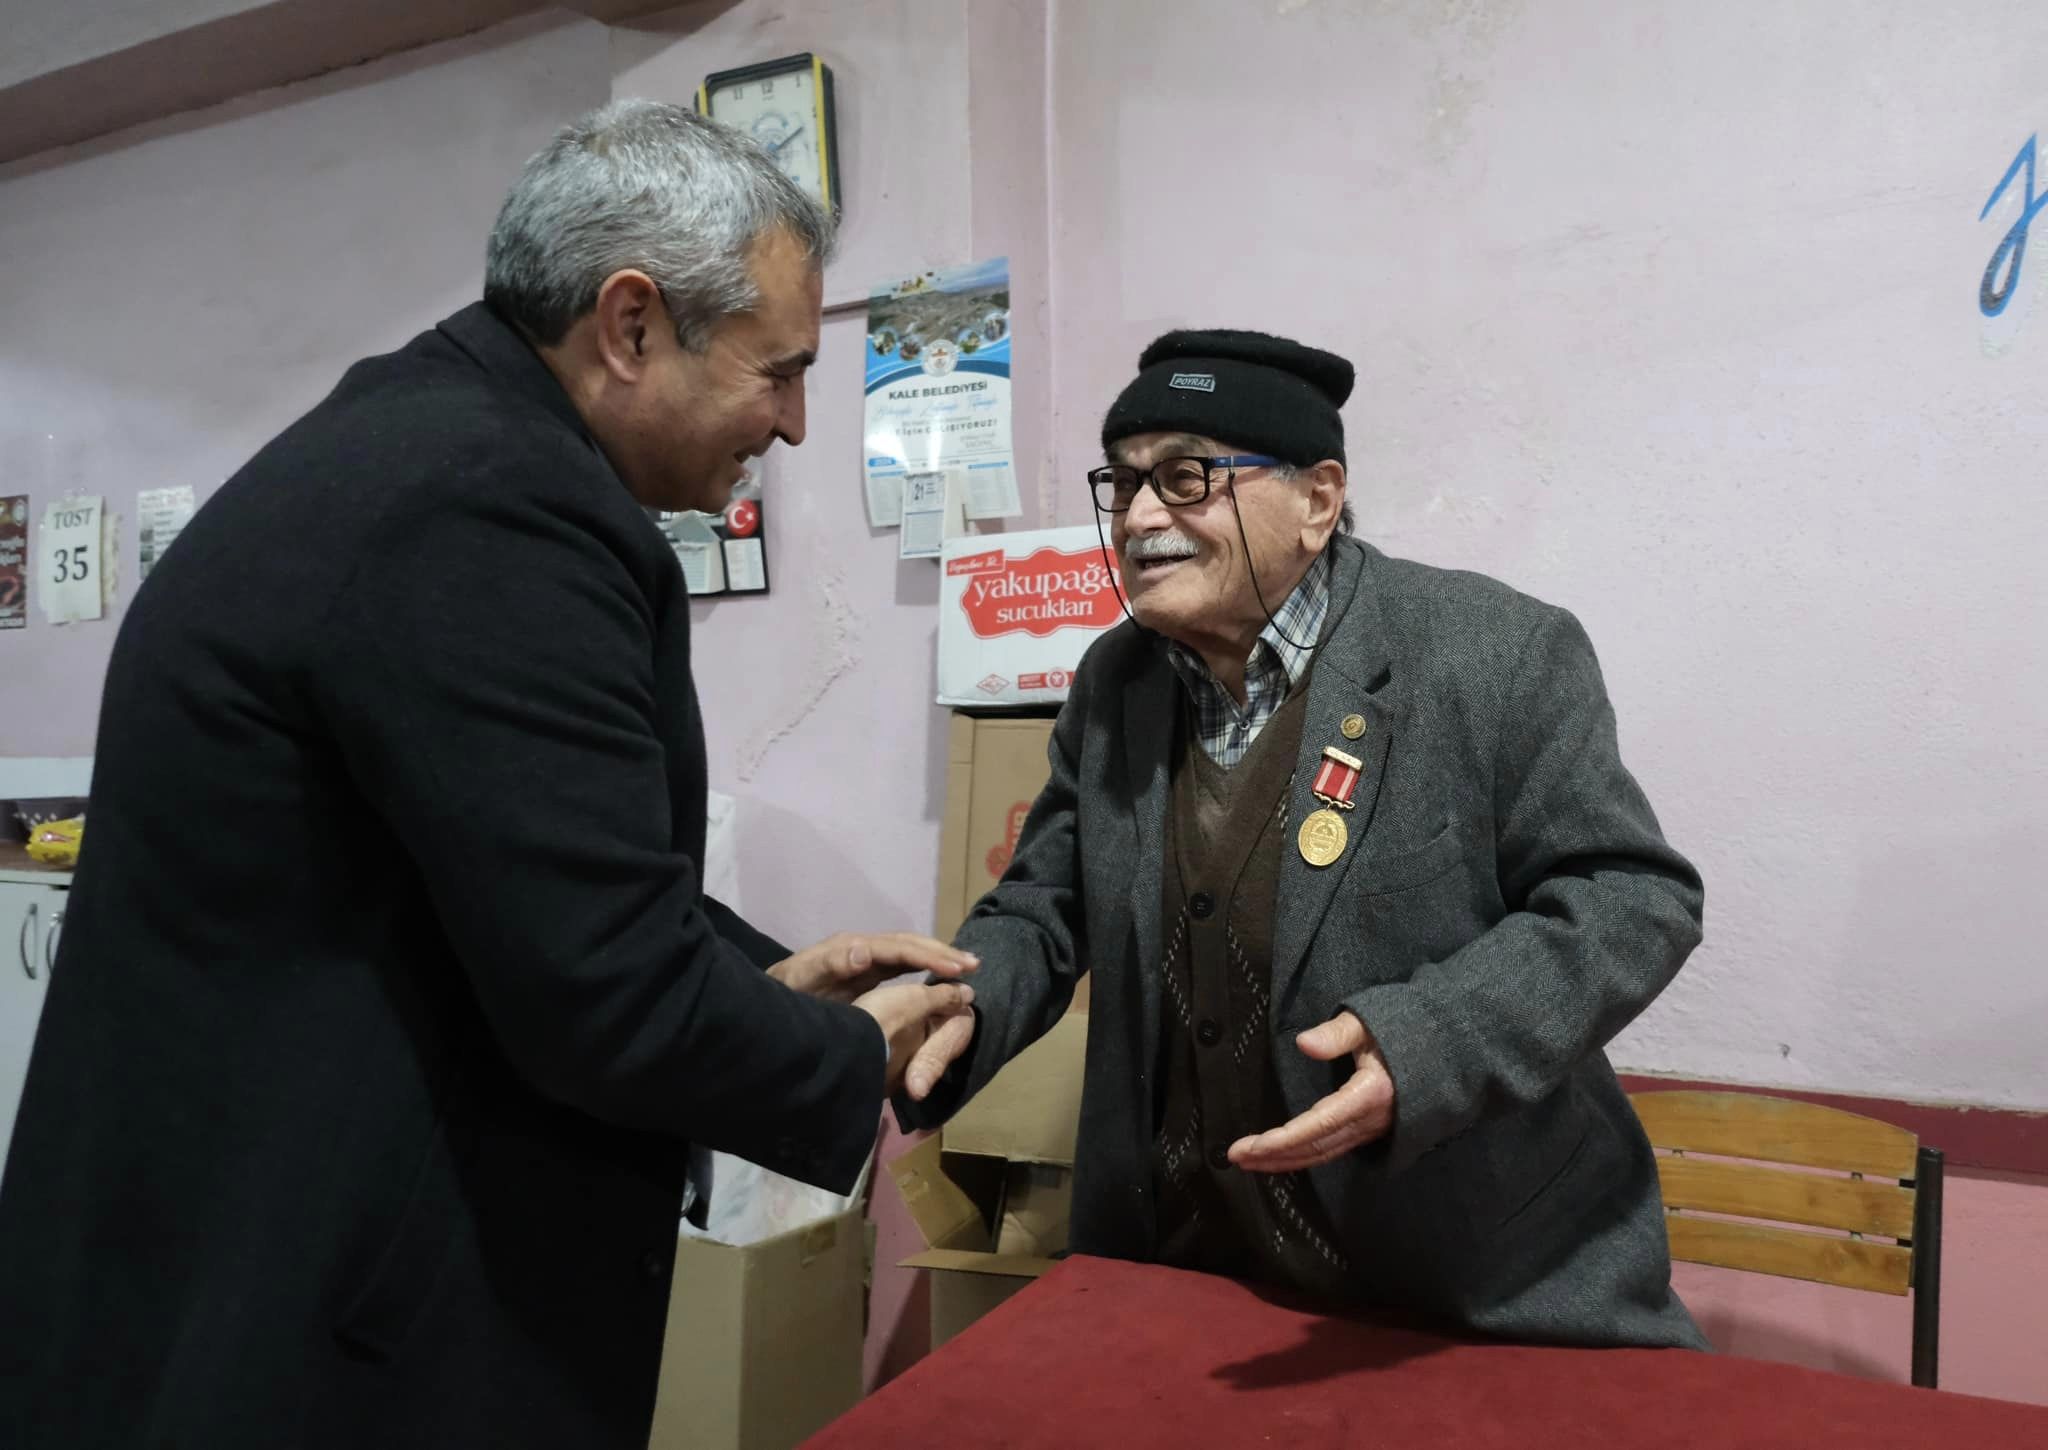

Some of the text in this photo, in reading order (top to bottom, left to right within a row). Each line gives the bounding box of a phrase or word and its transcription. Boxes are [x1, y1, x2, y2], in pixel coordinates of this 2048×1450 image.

[889, 380, 988, 400] KALE BELEDİYESİ
[1174, 377, 1211, 387] POYRAZ
[53, 507, 94, 529] TOST
[54, 544, 88, 583] 35
[974, 562, 1120, 607] yakupağa
[996, 598, 1093, 623] sucukları
